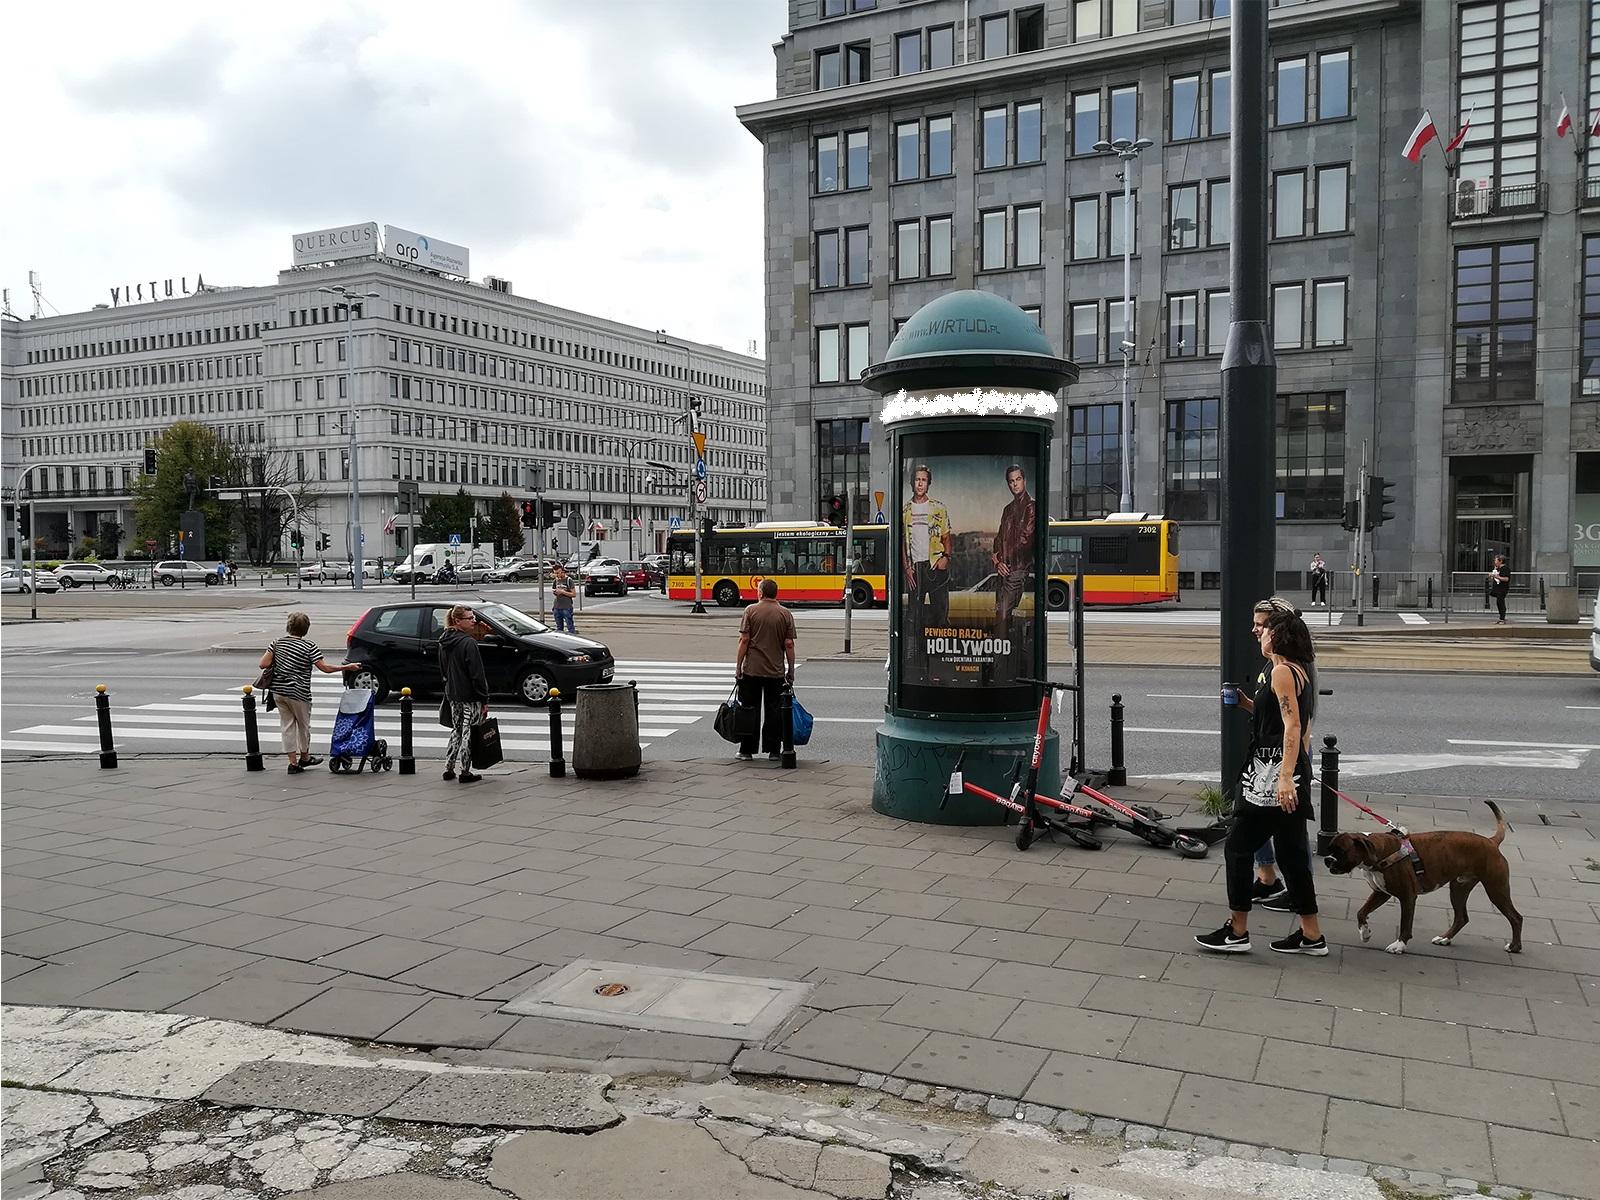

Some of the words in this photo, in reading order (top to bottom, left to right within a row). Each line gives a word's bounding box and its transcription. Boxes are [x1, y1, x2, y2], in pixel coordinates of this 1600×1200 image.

[294, 227, 372, 253] QUERCUS
[396, 243, 419, 262] arp
[110, 272, 206, 308] VISTULA
[1138, 526, 1157, 534] 7302
[924, 627, 957, 638] PEWNEGO
[958, 628, 983, 640] RAZU
[926, 638, 1012, 656] HOLLYWOOD
